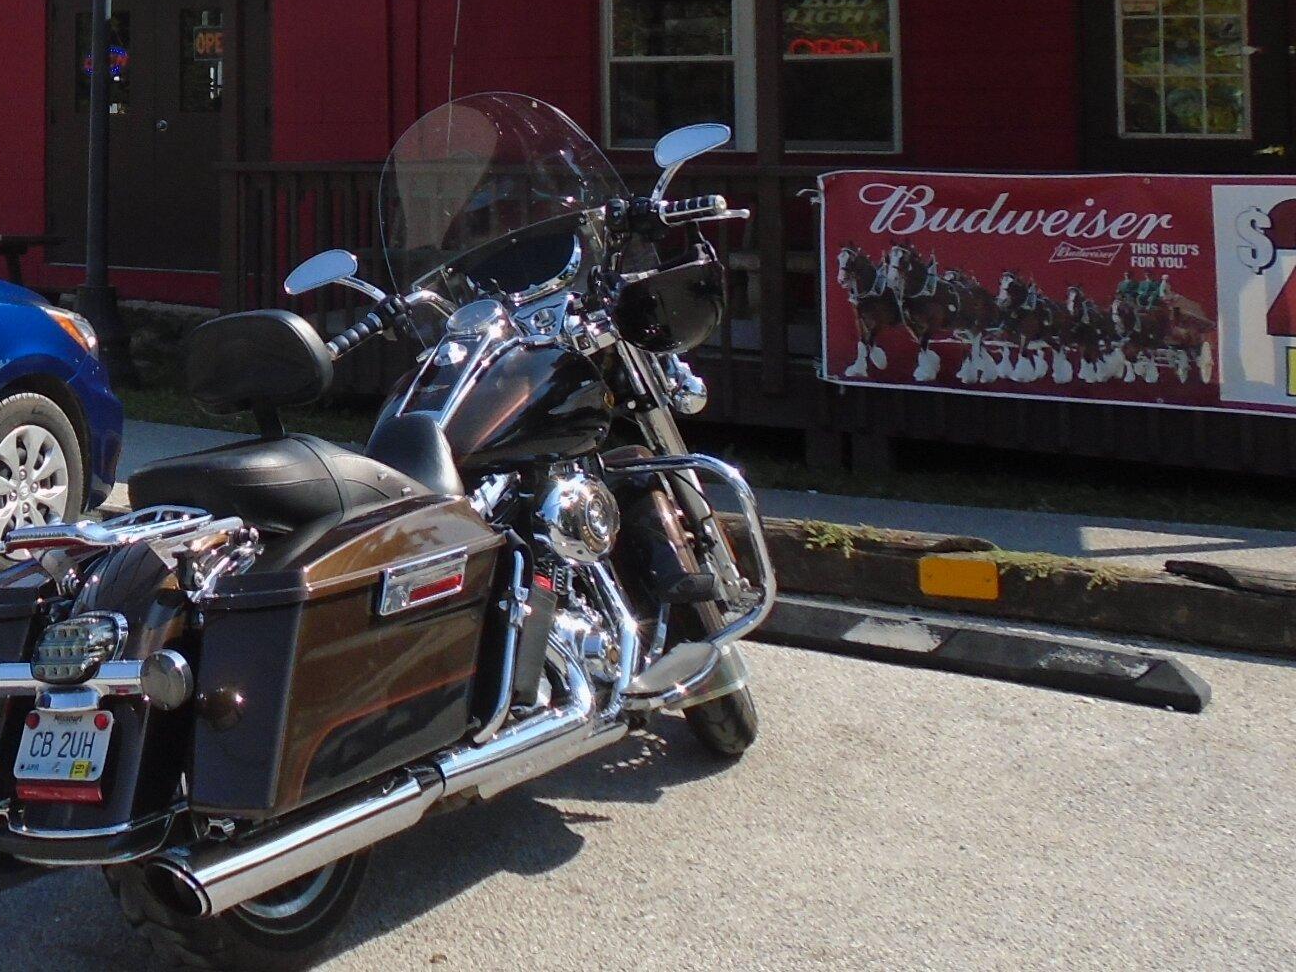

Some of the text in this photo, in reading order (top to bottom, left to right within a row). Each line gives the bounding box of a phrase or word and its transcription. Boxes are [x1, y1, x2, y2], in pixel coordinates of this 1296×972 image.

[196, 31, 224, 55] OPE
[858, 183, 1174, 240] Budweiser
[1130, 242, 1200, 256] THIS BUD'S
[1131, 256, 1155, 268] FOR
[29, 731, 96, 759] CB 2UH
